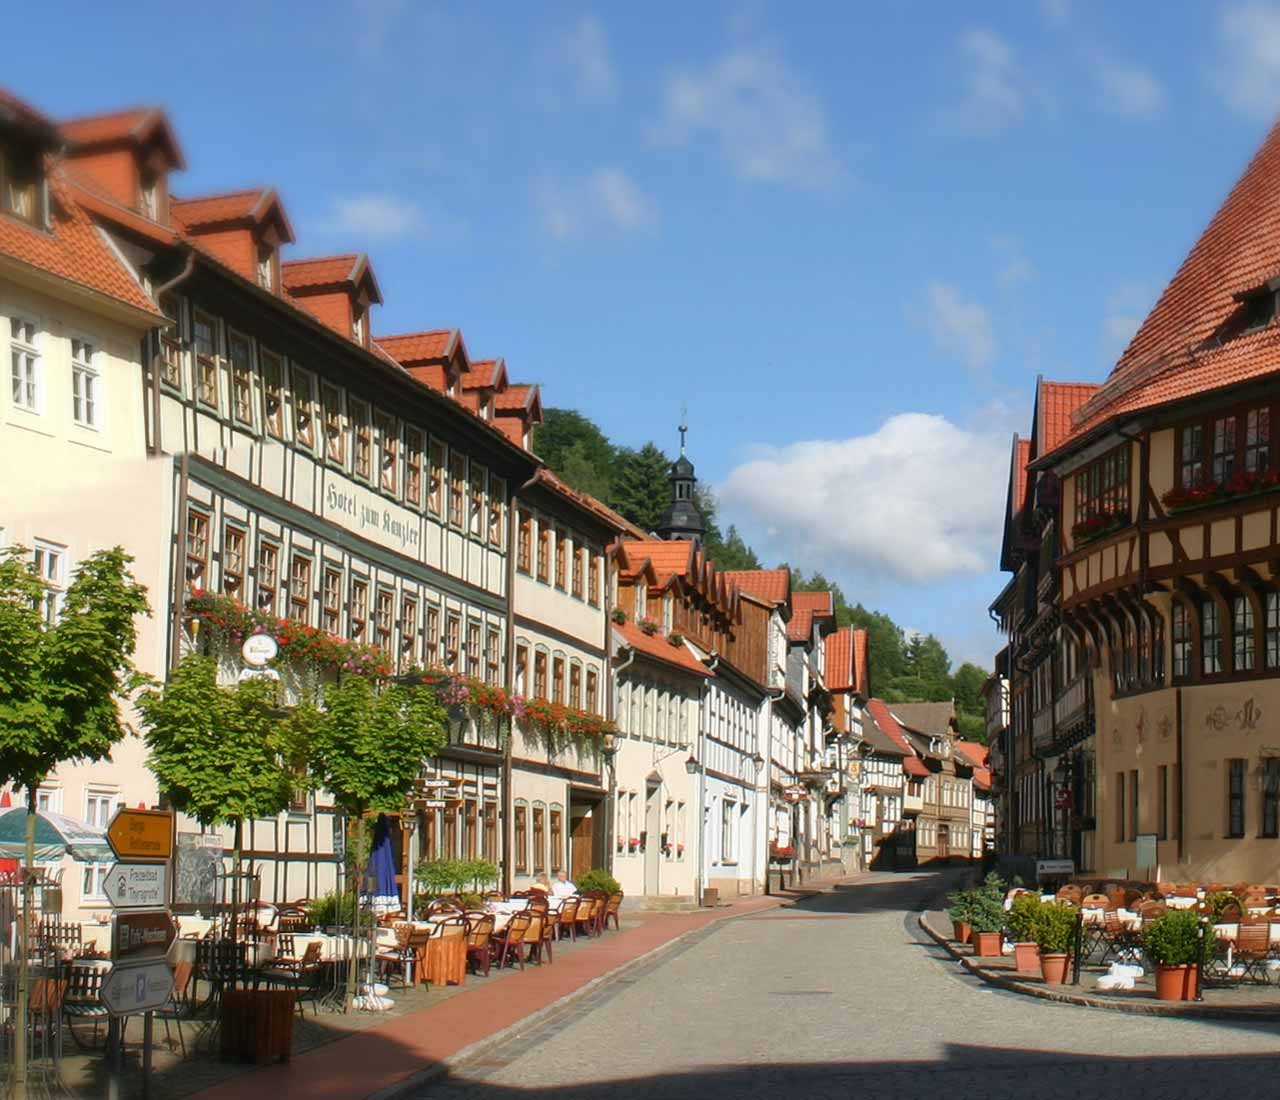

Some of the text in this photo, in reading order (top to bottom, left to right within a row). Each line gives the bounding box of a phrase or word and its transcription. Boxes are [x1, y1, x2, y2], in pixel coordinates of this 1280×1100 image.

[326, 483, 418, 548] Hotel zum Kanzler
